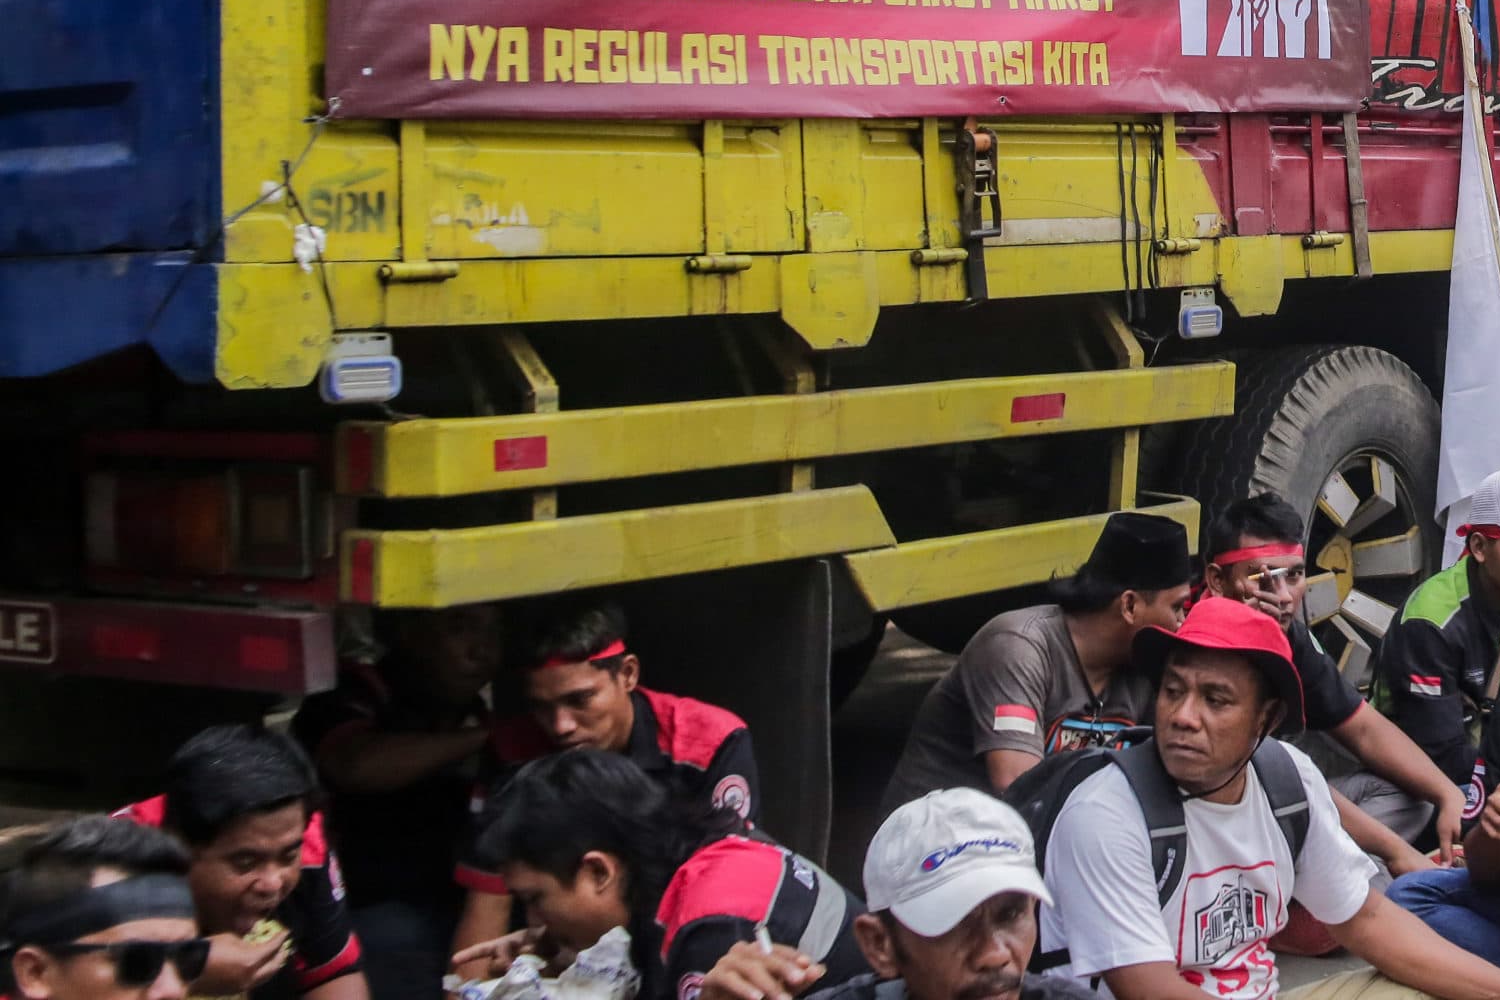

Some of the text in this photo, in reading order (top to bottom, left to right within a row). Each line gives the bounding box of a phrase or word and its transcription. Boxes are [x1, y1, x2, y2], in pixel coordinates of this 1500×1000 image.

[429, 23, 1110, 88] NYA REGULASI TRANSPORTASI KITA
